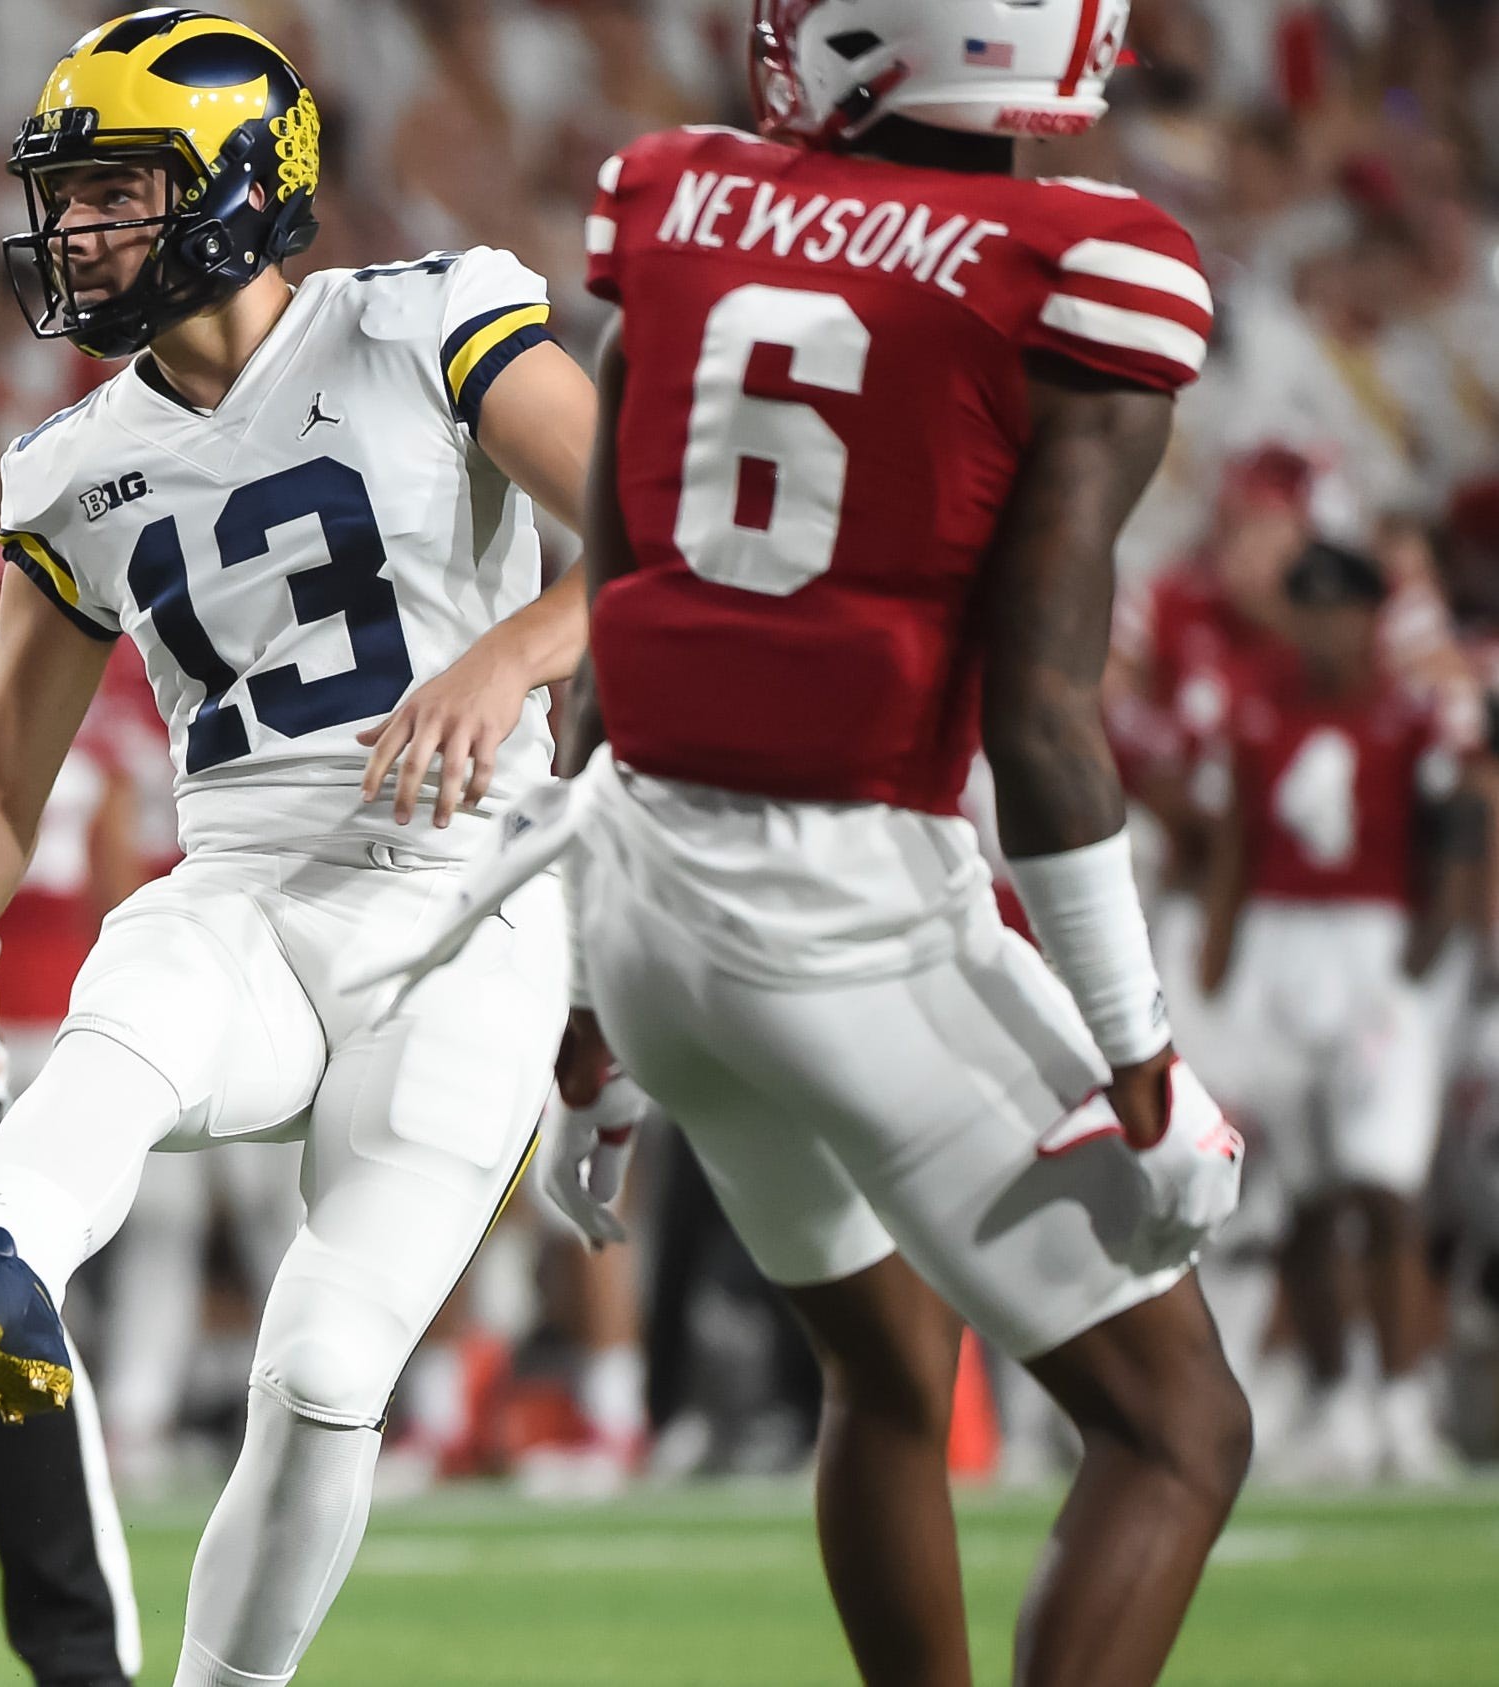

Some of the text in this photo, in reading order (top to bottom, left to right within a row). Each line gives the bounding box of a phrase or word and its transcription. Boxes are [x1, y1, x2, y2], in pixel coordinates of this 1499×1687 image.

[42, 110, 63, 132] M
[657, 169, 1008, 298] NEWSOME
[673, 282, 871, 597] 6
[127, 455, 414, 776] 13
[1272, 724, 1359, 871] 4
